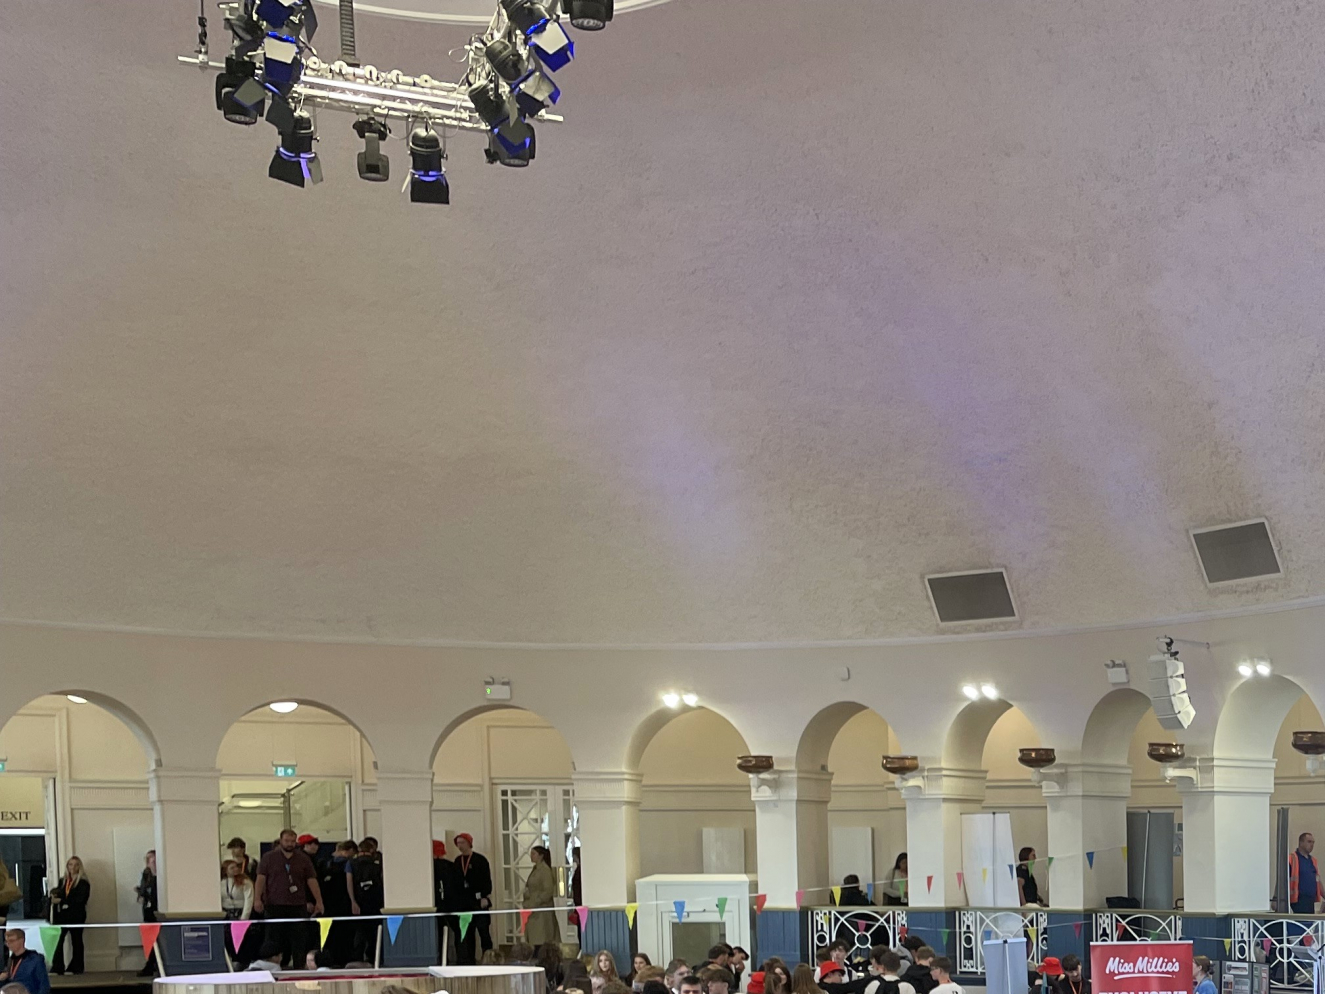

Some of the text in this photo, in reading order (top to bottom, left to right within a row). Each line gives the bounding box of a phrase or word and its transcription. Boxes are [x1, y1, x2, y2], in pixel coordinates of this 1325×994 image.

[1, 811, 31, 821] EXIT
[1106, 956, 1180, 974] Miss Millie's
